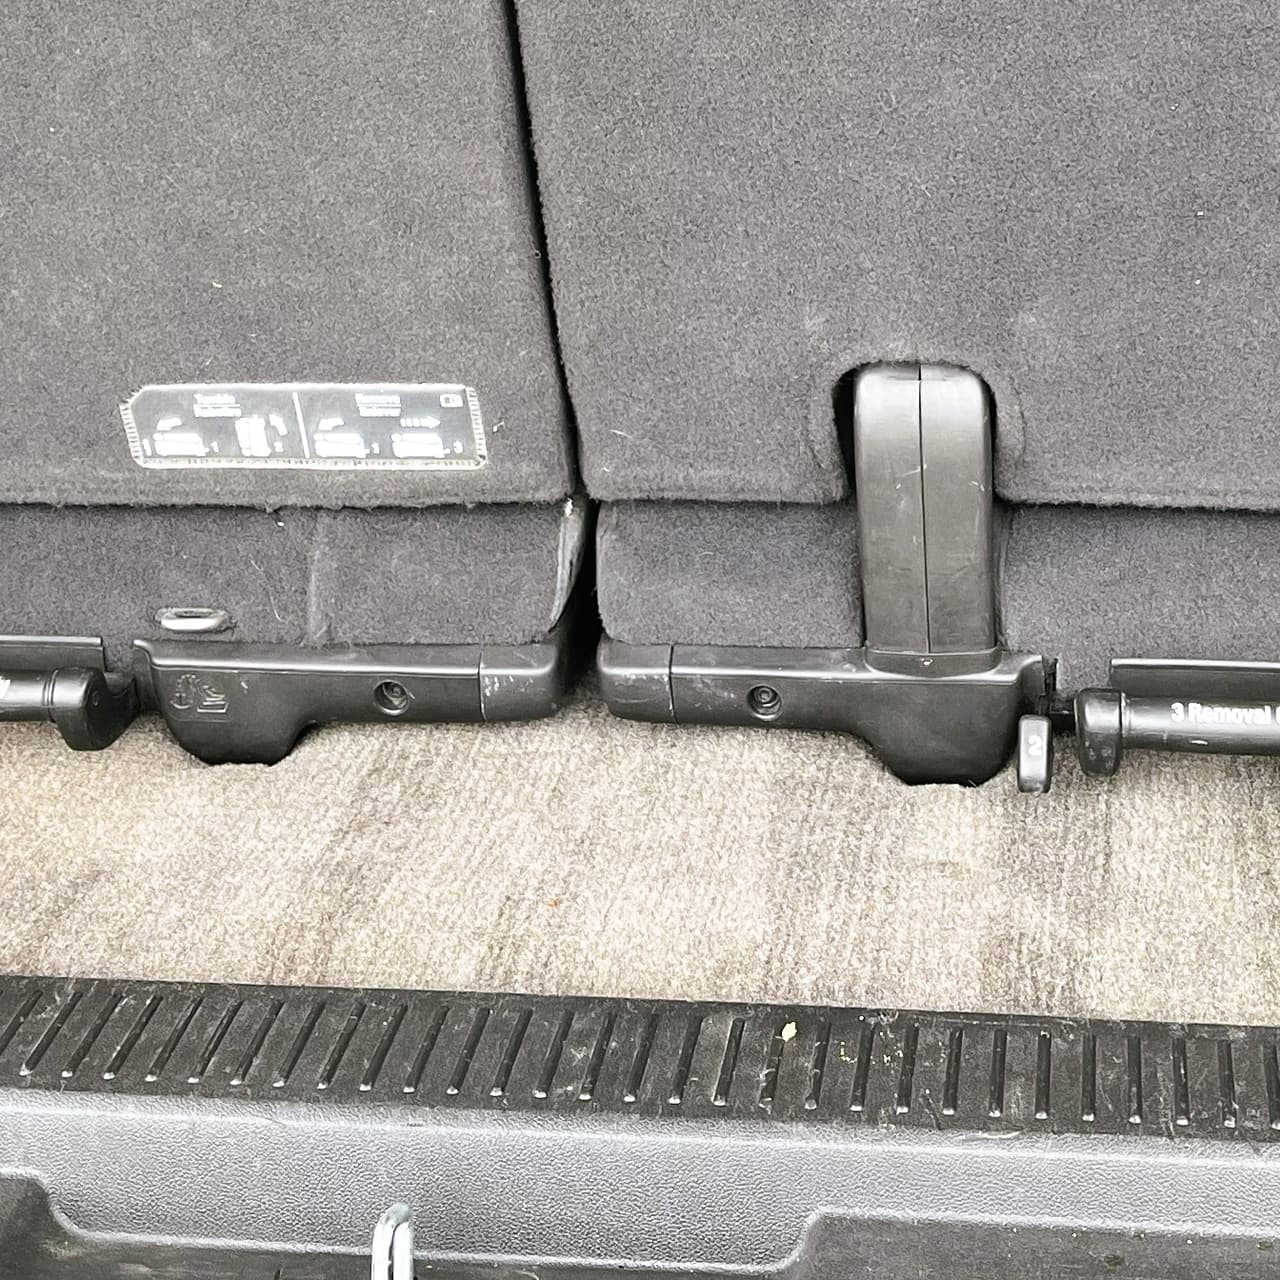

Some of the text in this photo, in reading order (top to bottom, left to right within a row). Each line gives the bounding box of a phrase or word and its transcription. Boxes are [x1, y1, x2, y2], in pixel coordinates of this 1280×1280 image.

[1170, 702, 1184, 723] 3
[1188, 702, 1271, 726] Removal
[1028, 735, 1042, 756] 2
